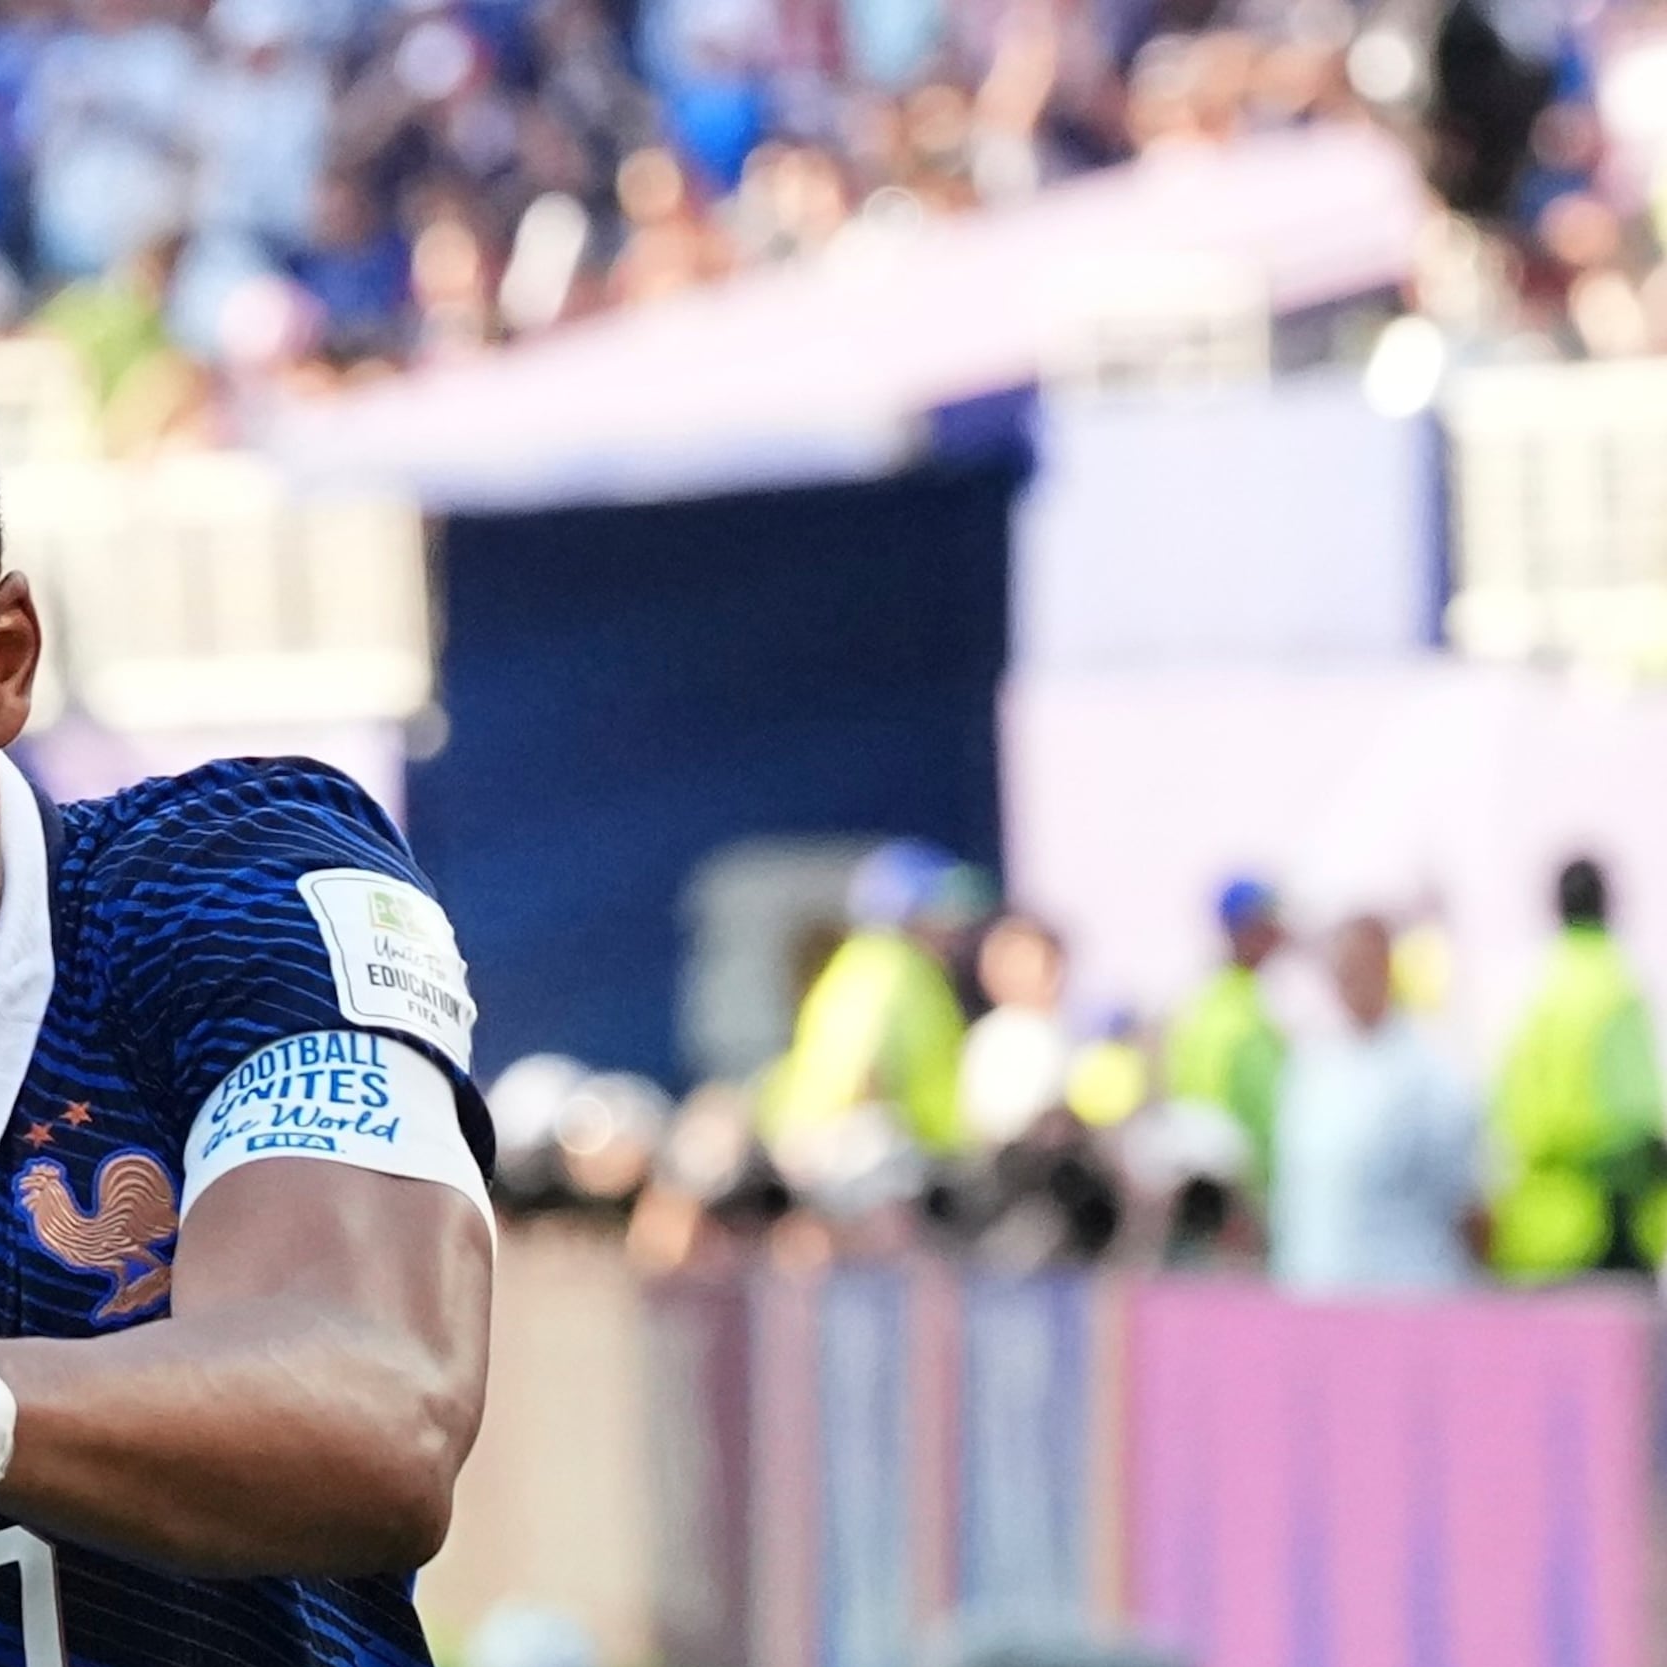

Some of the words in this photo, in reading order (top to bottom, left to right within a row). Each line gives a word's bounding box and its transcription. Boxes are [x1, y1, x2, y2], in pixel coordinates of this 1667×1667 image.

[367, 962, 462, 1026] EDUCATION
[407, 998, 441, 1030] FIFA
[221, 1031, 388, 1101] FOOTBALL
[211, 1069, 390, 1125] UNITES
[248, 1132, 335, 1152] FIFA
[270, 1103, 399, 1143] World
